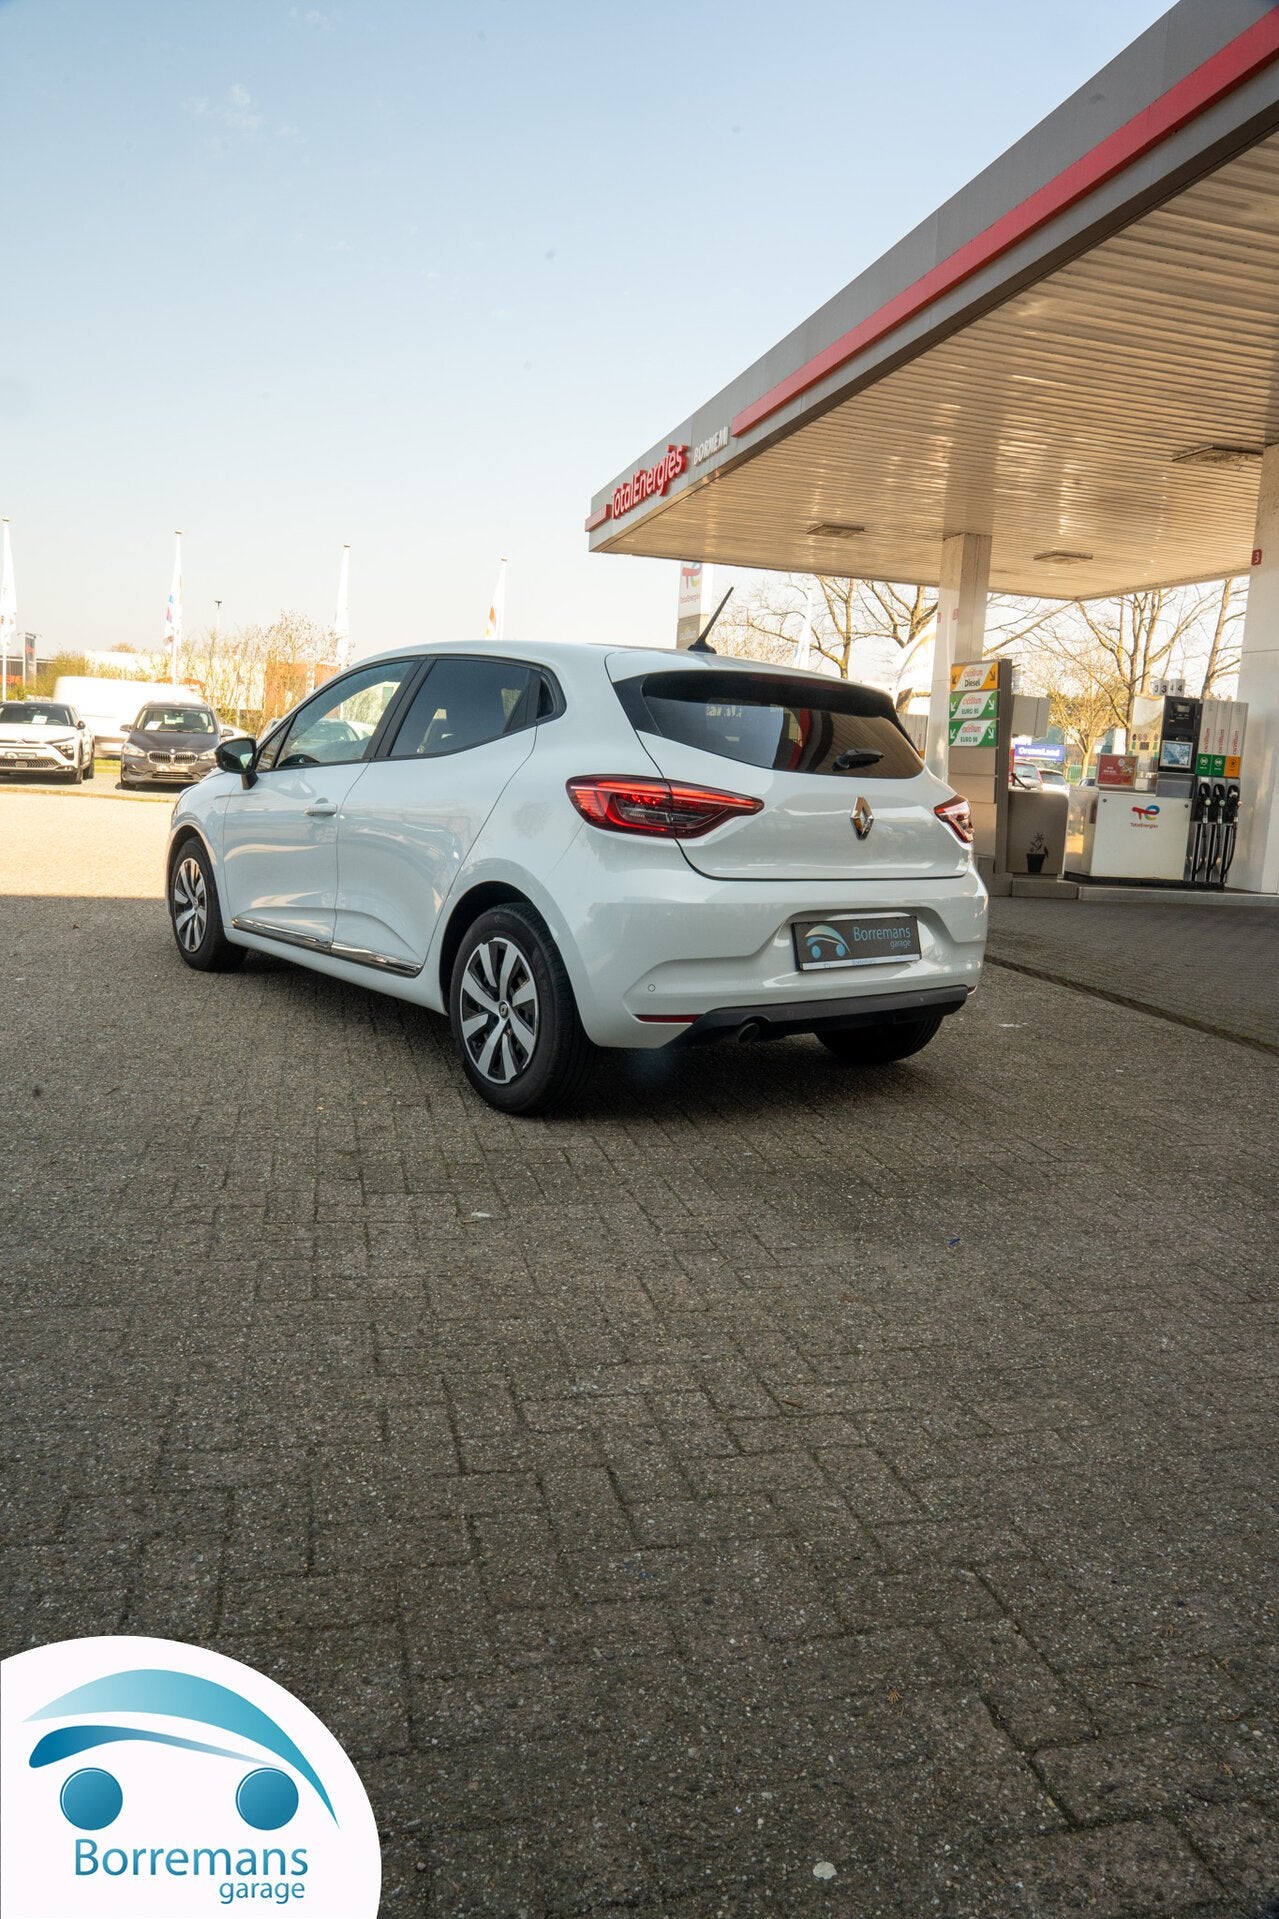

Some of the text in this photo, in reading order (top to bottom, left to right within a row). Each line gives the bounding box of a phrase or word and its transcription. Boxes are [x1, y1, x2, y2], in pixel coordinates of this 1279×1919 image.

[612, 426, 729, 519] TotalEnergies BORNEM
[964, 678, 980, 688] Diesel
[853, 926, 911, 941] Borremans
[890, 939, 911, 950] garage
